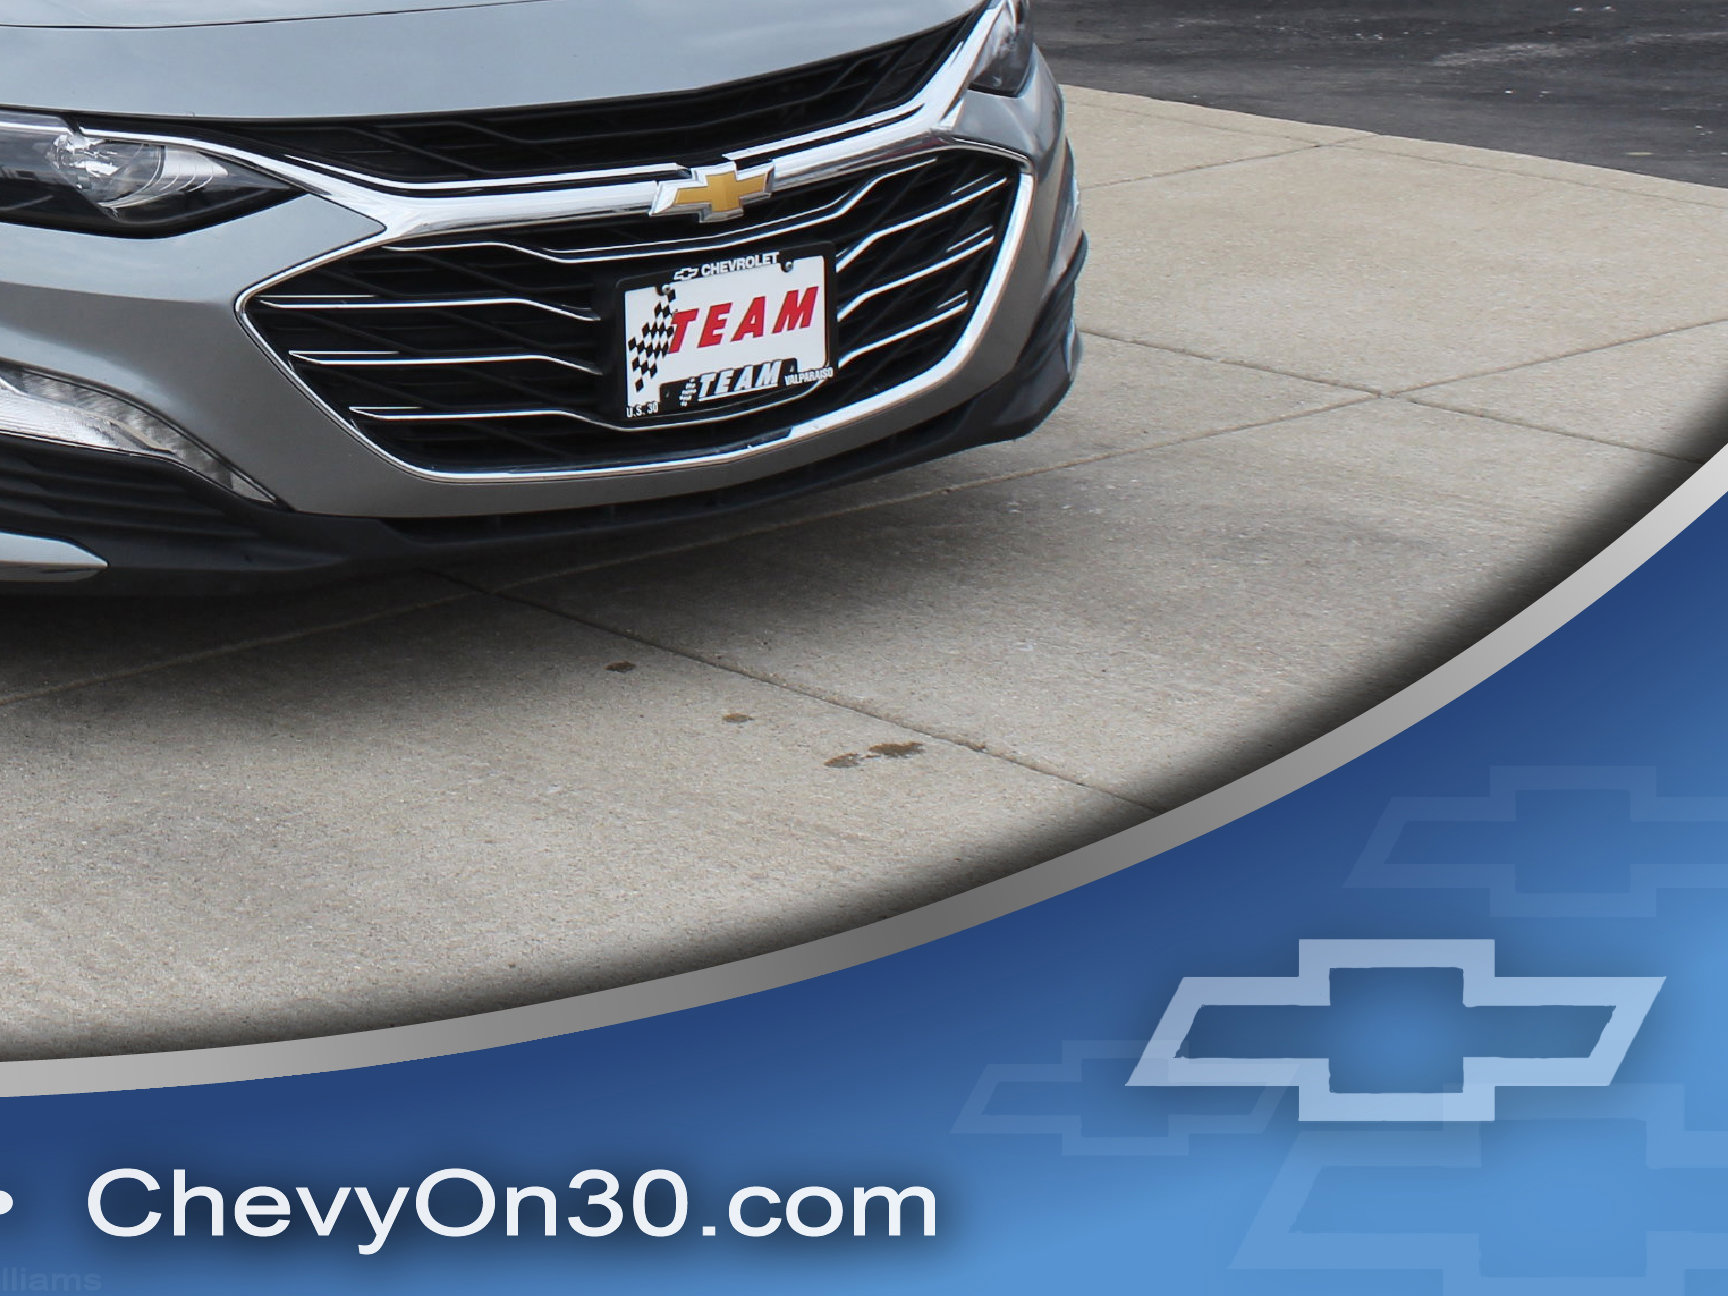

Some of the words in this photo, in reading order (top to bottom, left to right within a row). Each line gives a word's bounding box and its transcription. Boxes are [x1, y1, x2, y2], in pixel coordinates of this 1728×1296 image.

[701, 251, 780, 276] CHEVROLET
[667, 286, 819, 354] TEAM
[698, 360, 783, 398] TEAM
[784, 366, 834, 386] VALPARAISO
